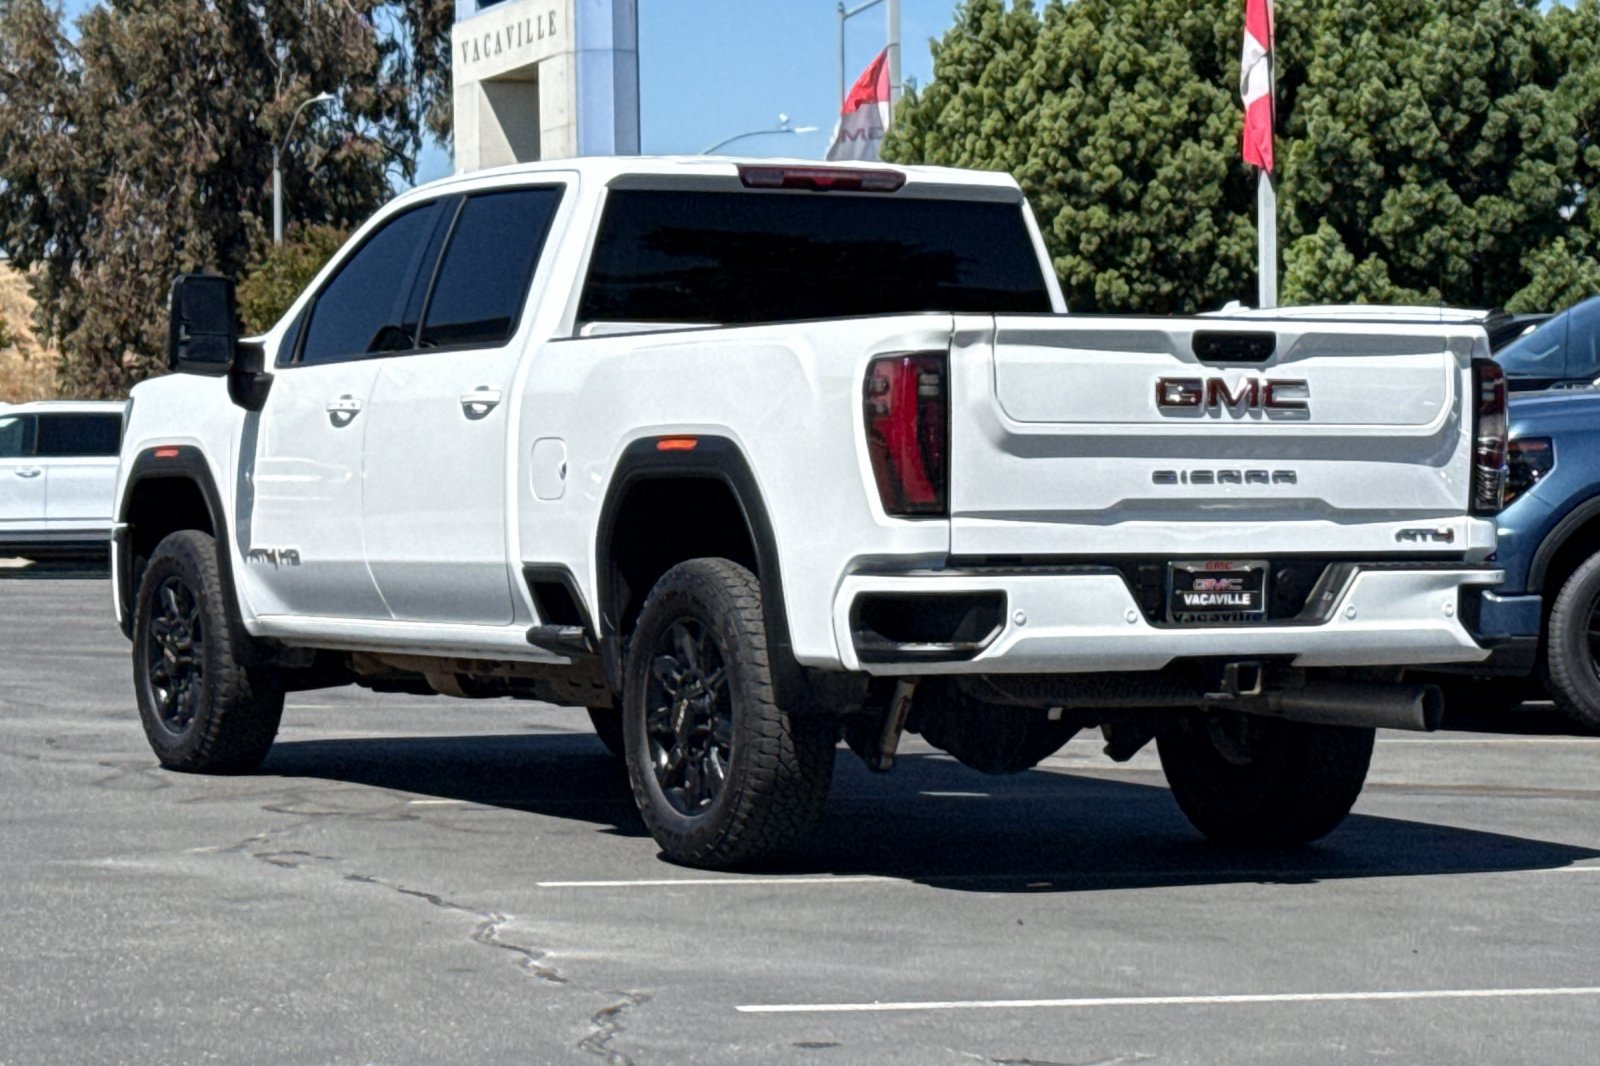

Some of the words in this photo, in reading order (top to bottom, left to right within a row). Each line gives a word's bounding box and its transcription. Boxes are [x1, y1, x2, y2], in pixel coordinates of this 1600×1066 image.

[461, 10, 557, 64] VACAVILLE
[1155, 377, 1311, 420] GMC
[1152, 470, 1297, 485] SIERRA
[1395, 528, 1454, 544] AT4
[278, 548, 300, 566] HD
[1193, 578, 1243, 590] GMC
[1183, 593, 1251, 605] VACAVILLE
